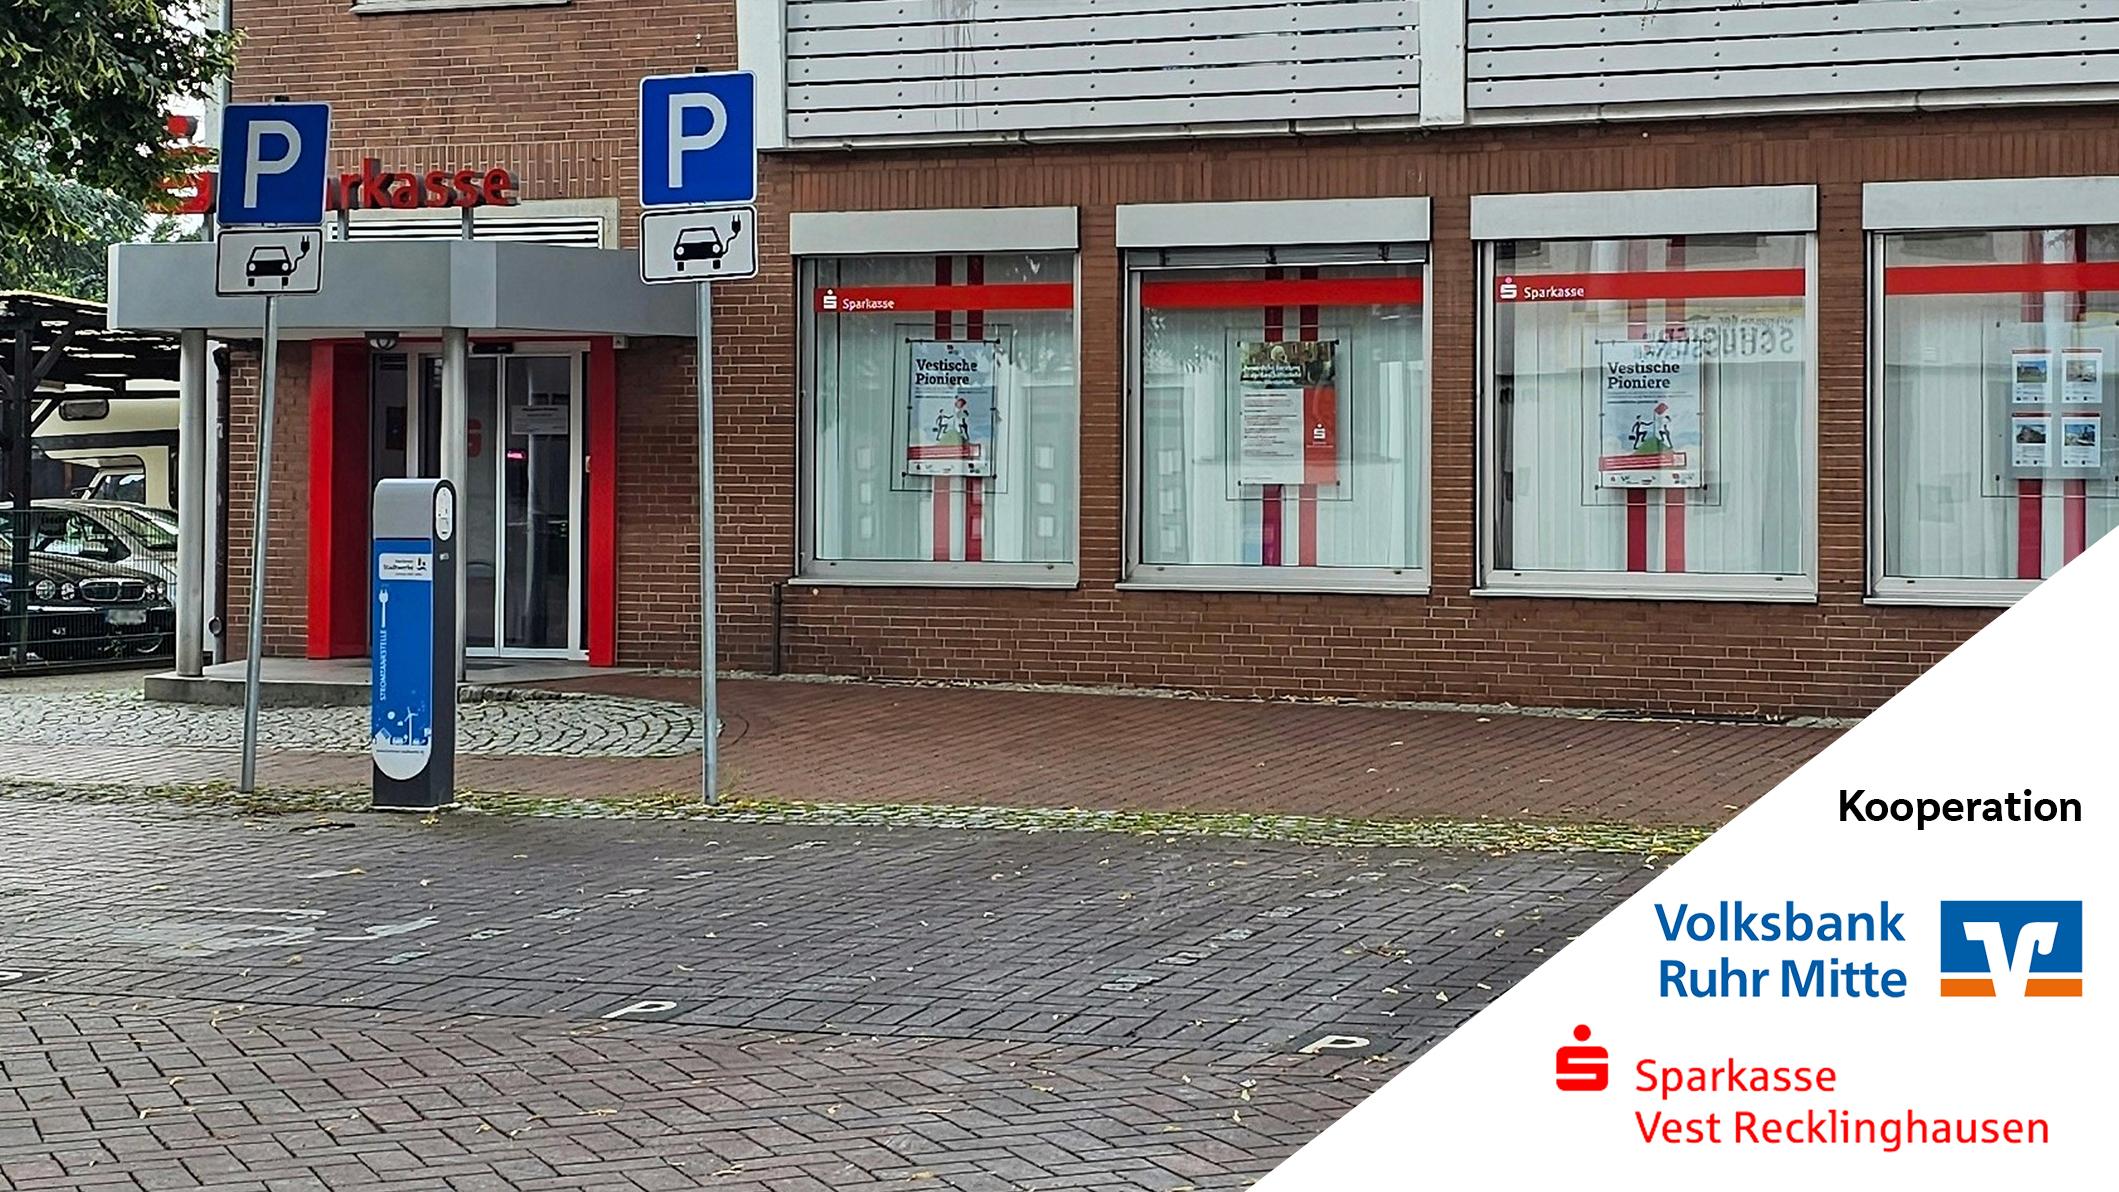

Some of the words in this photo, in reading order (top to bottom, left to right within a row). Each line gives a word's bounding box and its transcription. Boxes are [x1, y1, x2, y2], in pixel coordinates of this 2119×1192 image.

[668, 92, 728, 188] P
[244, 120, 302, 209] P
[326, 157, 518, 210] rkasse
[1523, 285, 1585, 300] Sparkasse
[842, 298, 896, 312] Sparkasse
[915, 358, 978, 372] Vestische
[1607, 360, 1680, 374] Vestische
[914, 373, 970, 386] Pioniere
[1607, 375, 1671, 389] Pioniere
